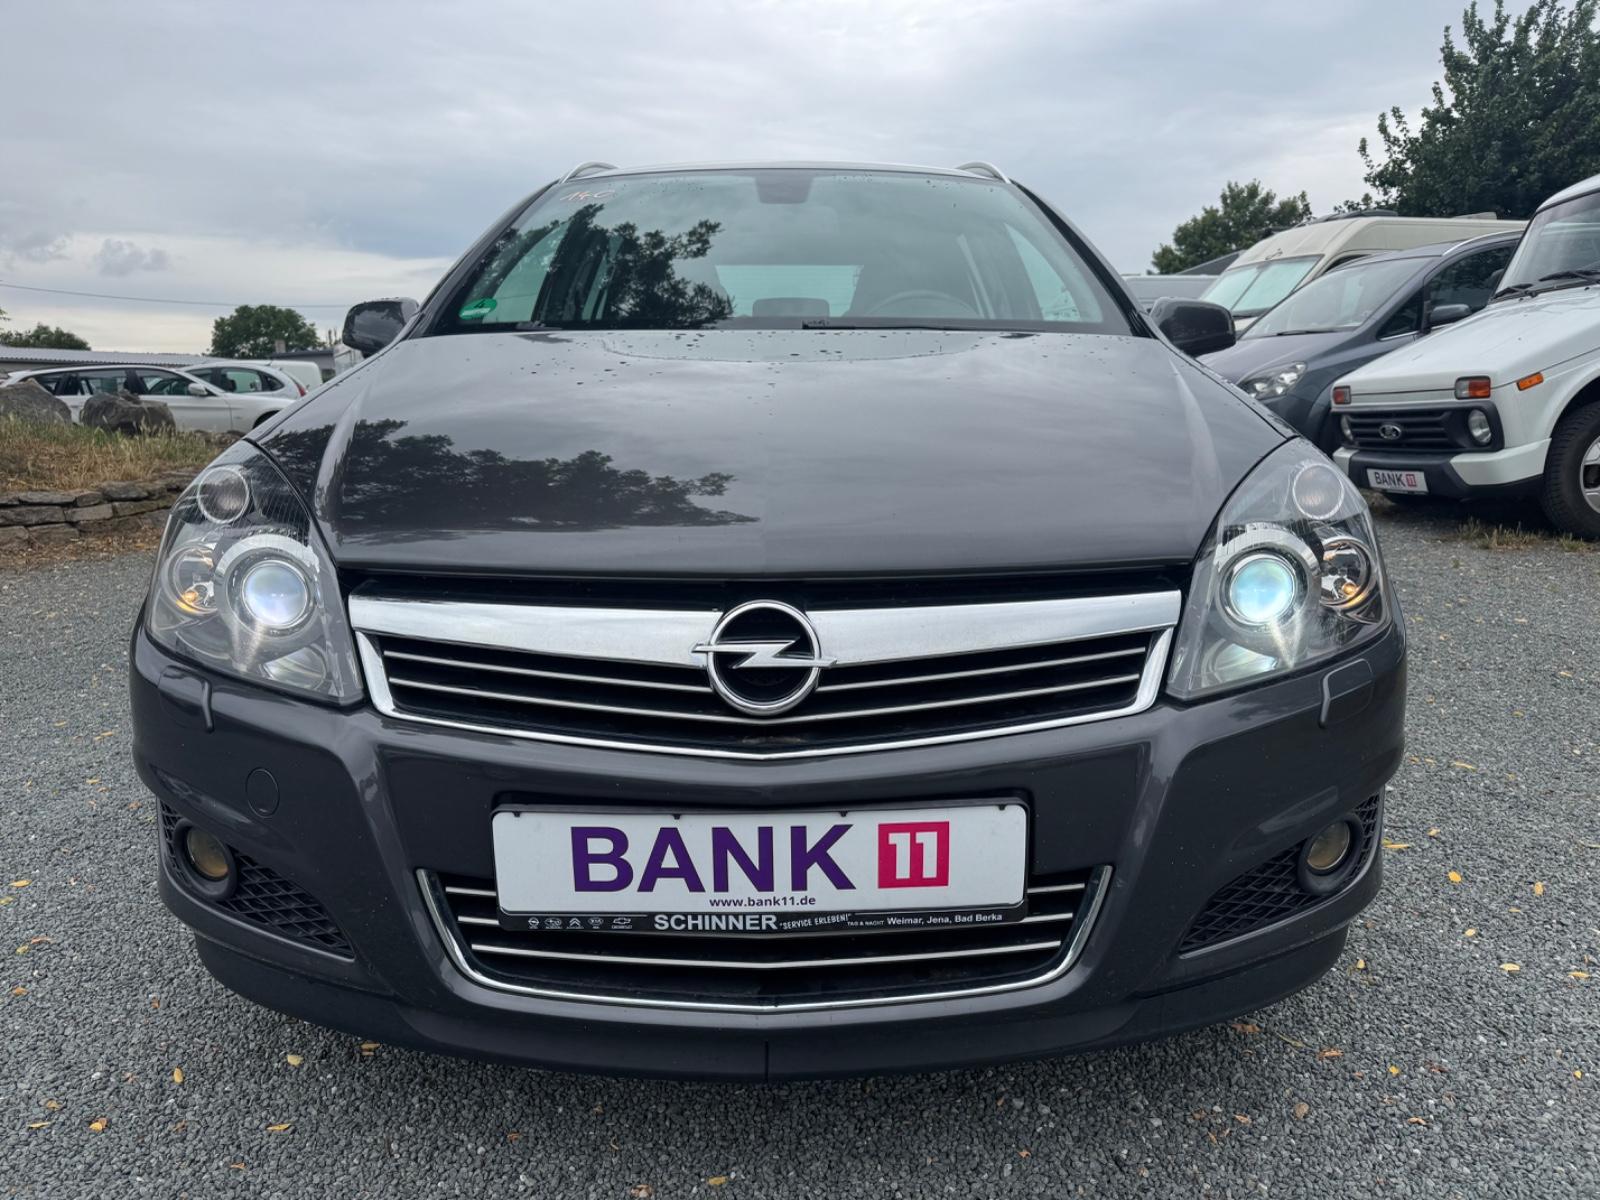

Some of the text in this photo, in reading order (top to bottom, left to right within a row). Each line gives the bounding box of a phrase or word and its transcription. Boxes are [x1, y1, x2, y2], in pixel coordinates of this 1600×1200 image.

[1374, 471, 1406, 487] BANK
[570, 823, 940, 893] BANK 11
[709, 896, 816, 907] www.bank11.de
[654, 914, 778, 931] SCHINNER
[886, 916, 925, 926] Weimar,
[926, 914, 952, 925] Jena,
[954, 914, 973, 924] Bad
[975, 912, 1003, 923] Berka
